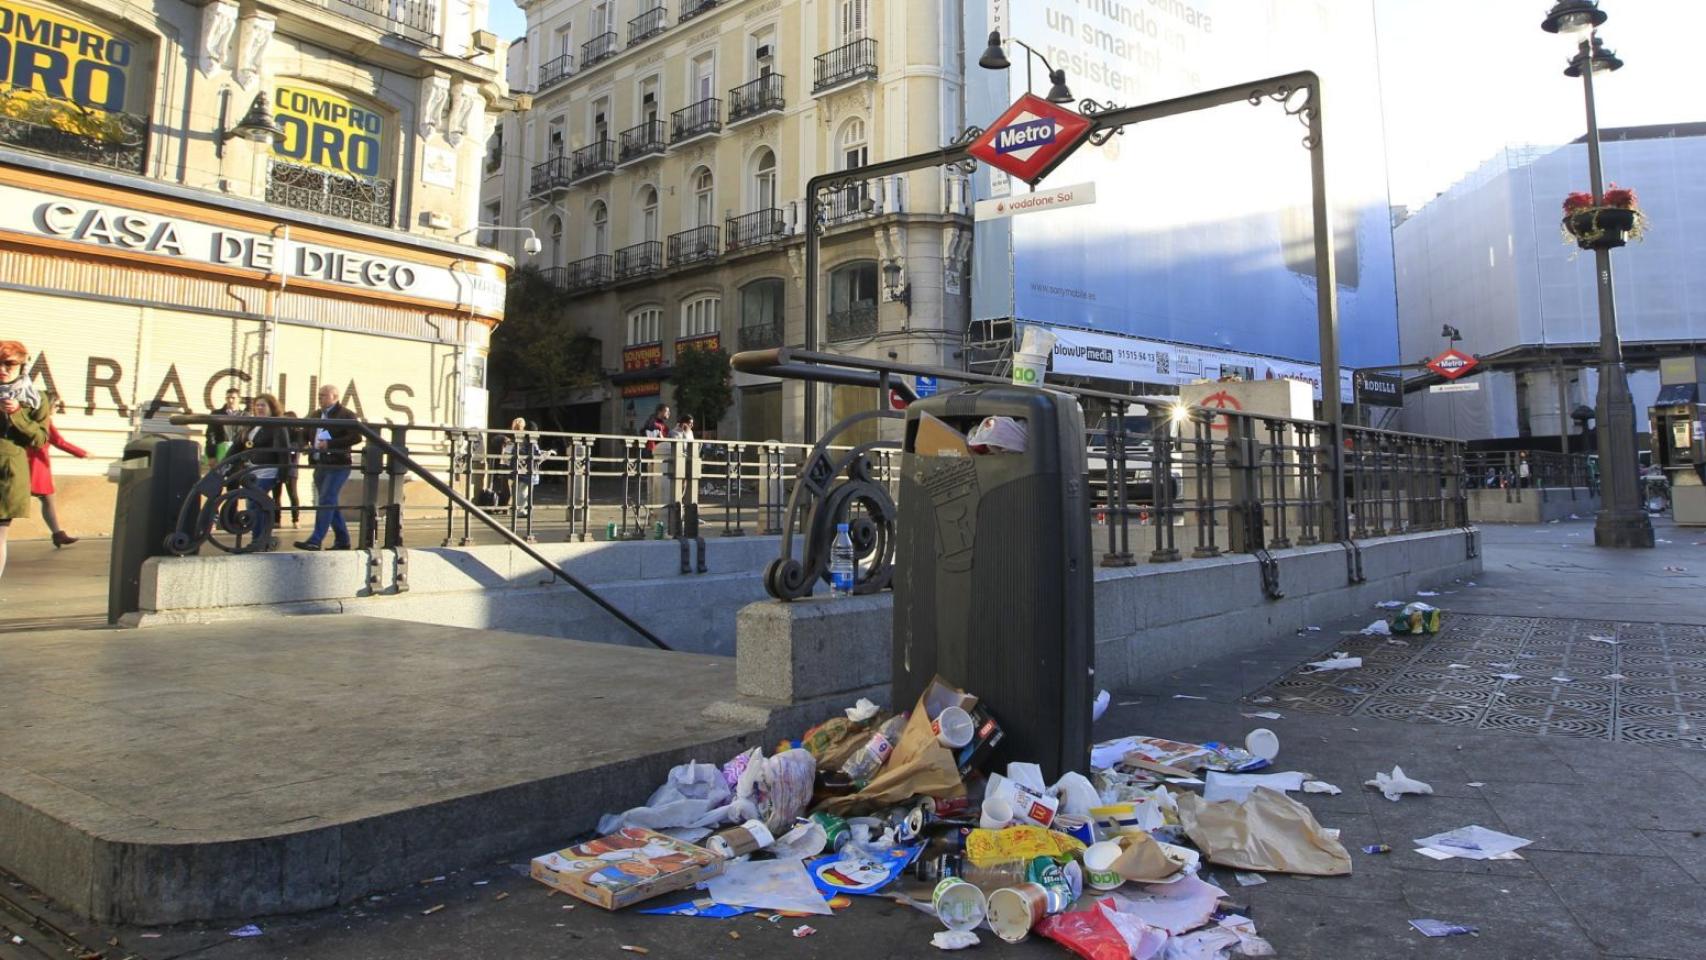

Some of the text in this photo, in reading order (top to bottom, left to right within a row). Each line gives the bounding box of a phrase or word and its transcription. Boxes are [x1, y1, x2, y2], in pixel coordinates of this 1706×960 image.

[1045, 6, 1075, 38] un
[0, 35, 126, 113] RO
[275, 87, 380, 135] COMPRO
[272, 113, 380, 177] ORO
[1000, 124, 1051, 148] Metro
[1009, 195, 1054, 210] vodafone
[33, 201, 415, 291] CASA DE DIEGO
[1440, 360, 1464, 368] Metro
[1364, 380, 1396, 394] RODILLA
